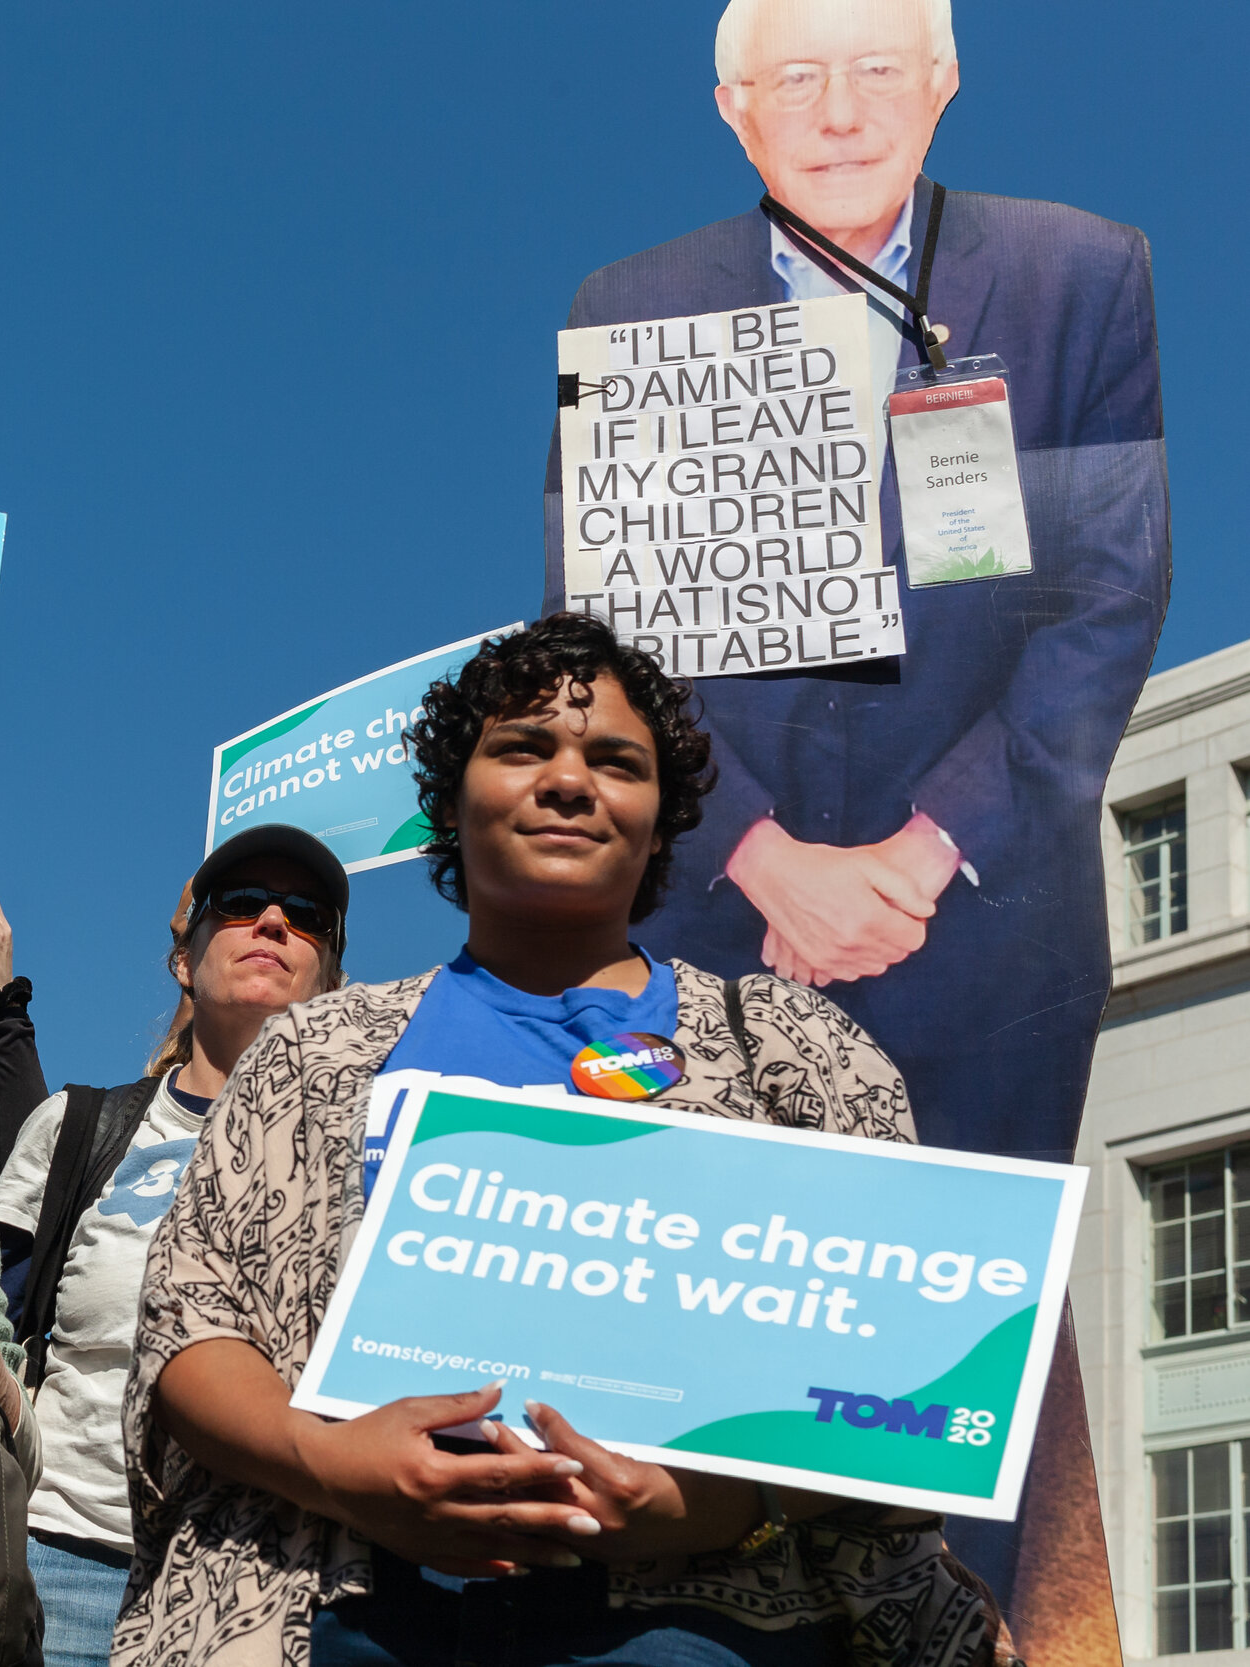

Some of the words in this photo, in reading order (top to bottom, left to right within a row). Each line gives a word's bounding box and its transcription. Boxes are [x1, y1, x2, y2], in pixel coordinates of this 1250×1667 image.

[731, 305, 803, 354] BE
[600, 347, 837, 414] DAMNED
[925, 389, 974, 405] BERNIE!!!
[594, 418, 637, 460] IF
[679, 390, 854, 450] LEAVE
[578, 460, 658, 502] MY
[667, 440, 867, 497] GRAND
[926, 469, 988, 489] Sanders
[930, 451, 979, 468] Bernie
[578, 486, 868, 546] CHILDREN
[937, 527, 962, 536] United
[963, 525, 986, 533] States
[941, 508, 976, 518] President
[949, 518, 956, 526] of
[958, 517, 971, 525] the
[604, 548, 640, 587] A
[654, 530, 863, 586] WORLD
[947, 544, 978, 553] America
[633, 612, 899, 673] BITABLE.”
[223, 728, 355, 799] Climate
[219, 756, 342, 826] cannot
[580, 1049, 654, 1075] TOM
[408, 1162, 700, 1251] Climate
[720, 1214, 1029, 1305] change
[386, 1229, 656, 1305] cannot
[676, 1272, 877, 1338] wait.
[351, 1334, 531, 1380] tomsteyer.com
[806, 1386, 950, 1440] TOM
[947, 1424, 992, 1447] 20
[951, 1407, 996, 1428] 20
